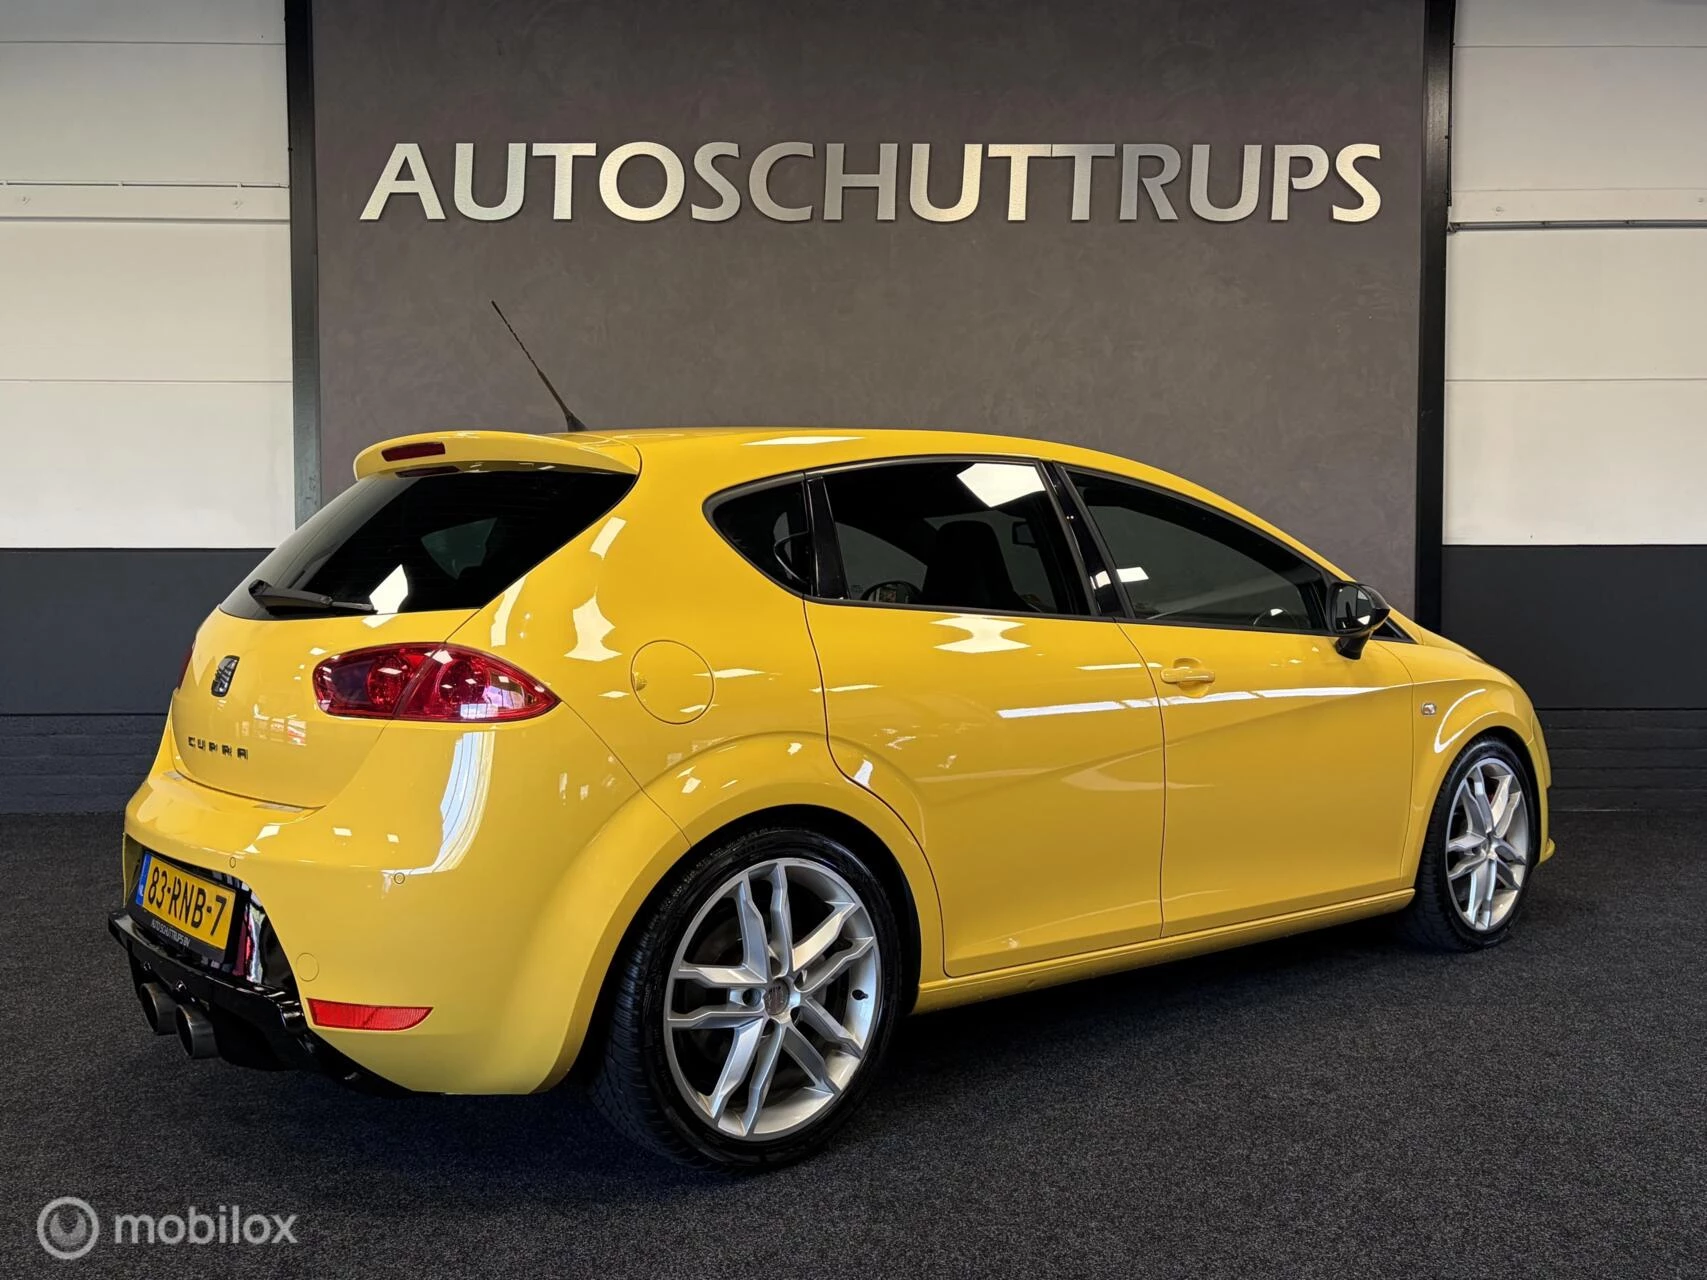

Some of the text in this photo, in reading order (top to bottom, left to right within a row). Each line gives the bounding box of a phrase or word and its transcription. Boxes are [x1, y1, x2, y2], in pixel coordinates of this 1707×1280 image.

[359, 141, 1382, 222] AUTOSCHUTTRUPS
[187, 736, 249, 760] CUPRA
[148, 866, 227, 936] 83-RNB-7
